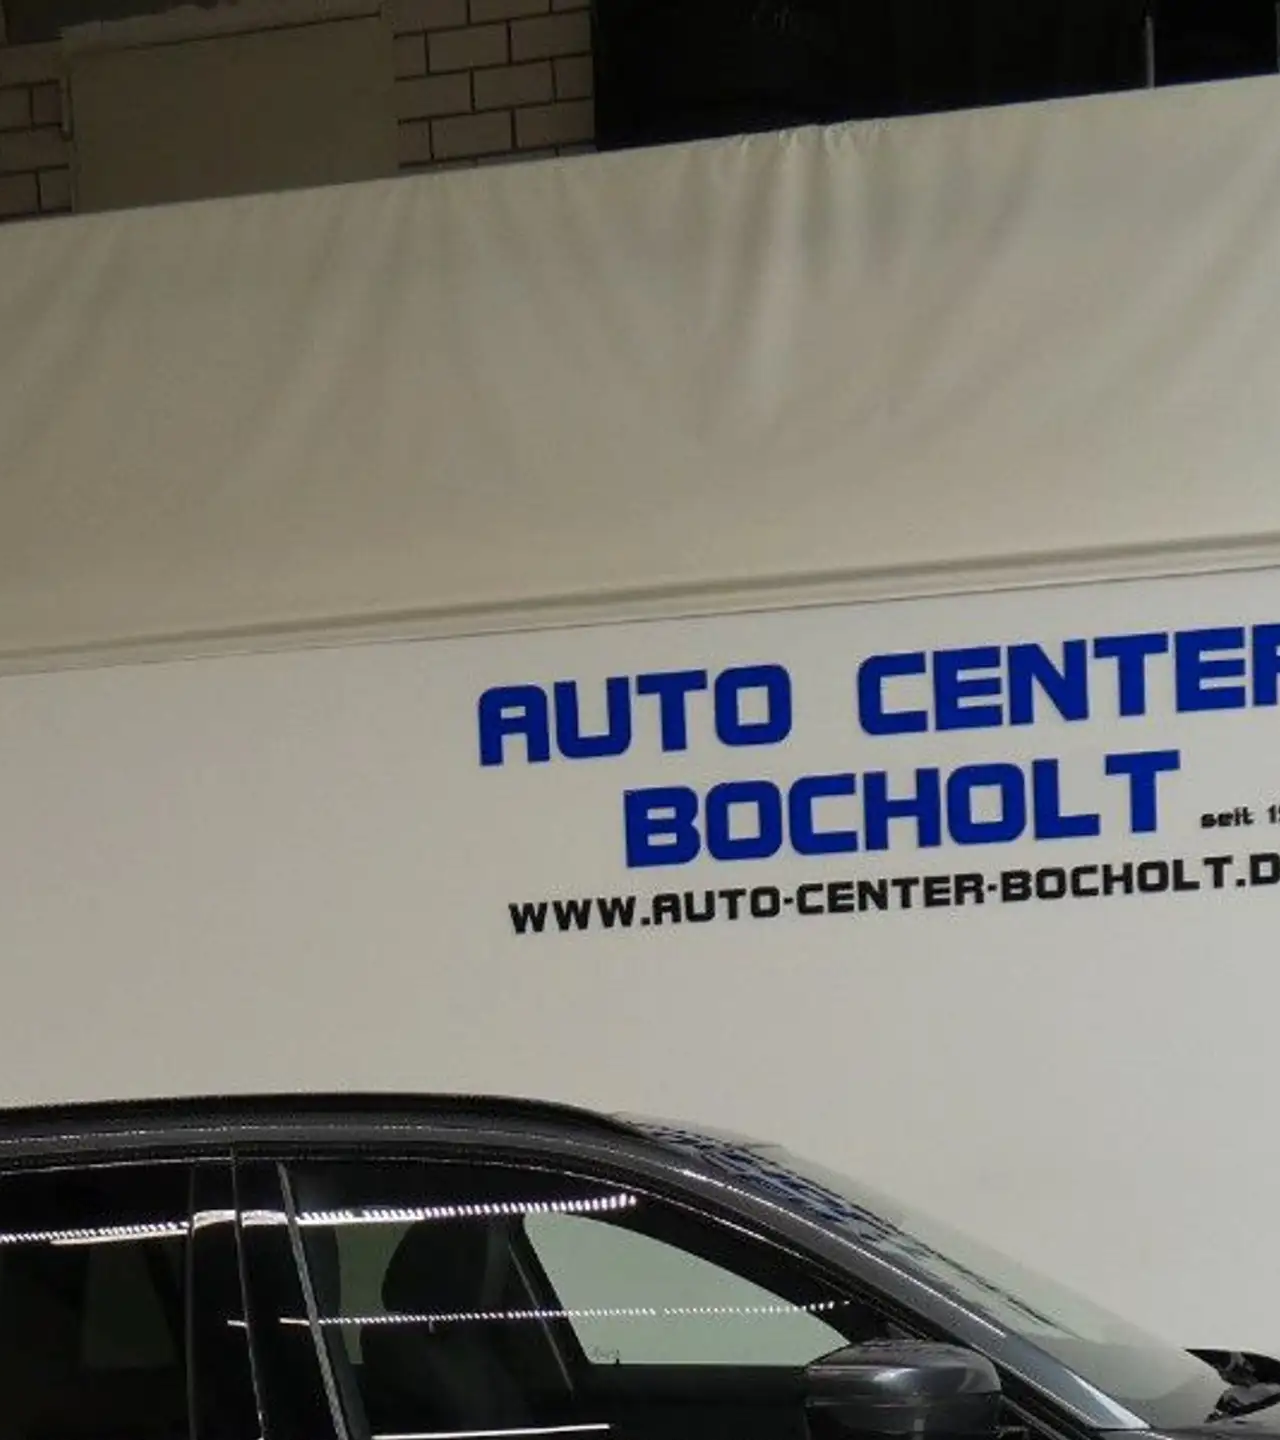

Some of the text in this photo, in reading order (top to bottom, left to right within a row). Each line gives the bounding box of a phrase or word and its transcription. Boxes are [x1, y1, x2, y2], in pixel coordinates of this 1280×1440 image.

[477, 664, 794, 767] AUTO
[623, 750, 1181, 869] BOCHOLT
[1200, 805, 1255, 830] seit
